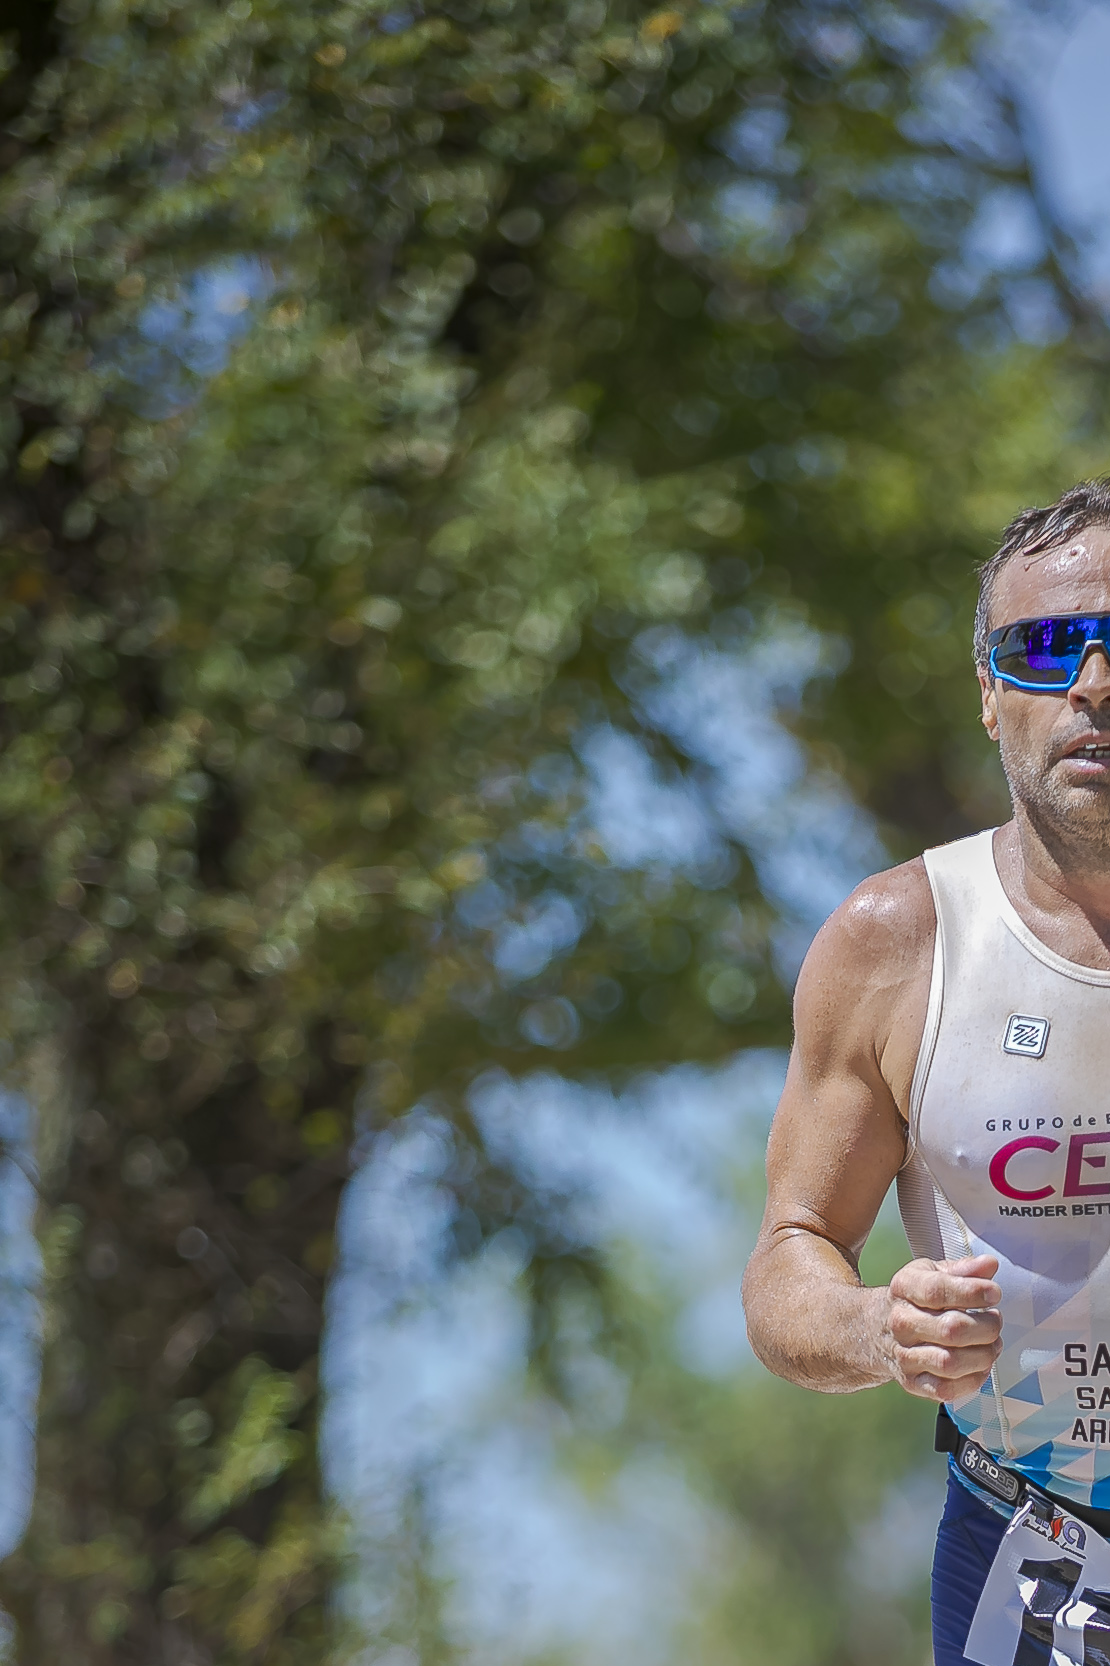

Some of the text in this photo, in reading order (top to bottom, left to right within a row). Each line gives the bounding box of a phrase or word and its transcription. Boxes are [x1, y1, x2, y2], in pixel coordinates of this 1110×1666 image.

[985, 1116, 1064, 1132] GRUPO
[1073, 1114, 1097, 1127] de
[998, 1204, 1067, 1217] HARDER
